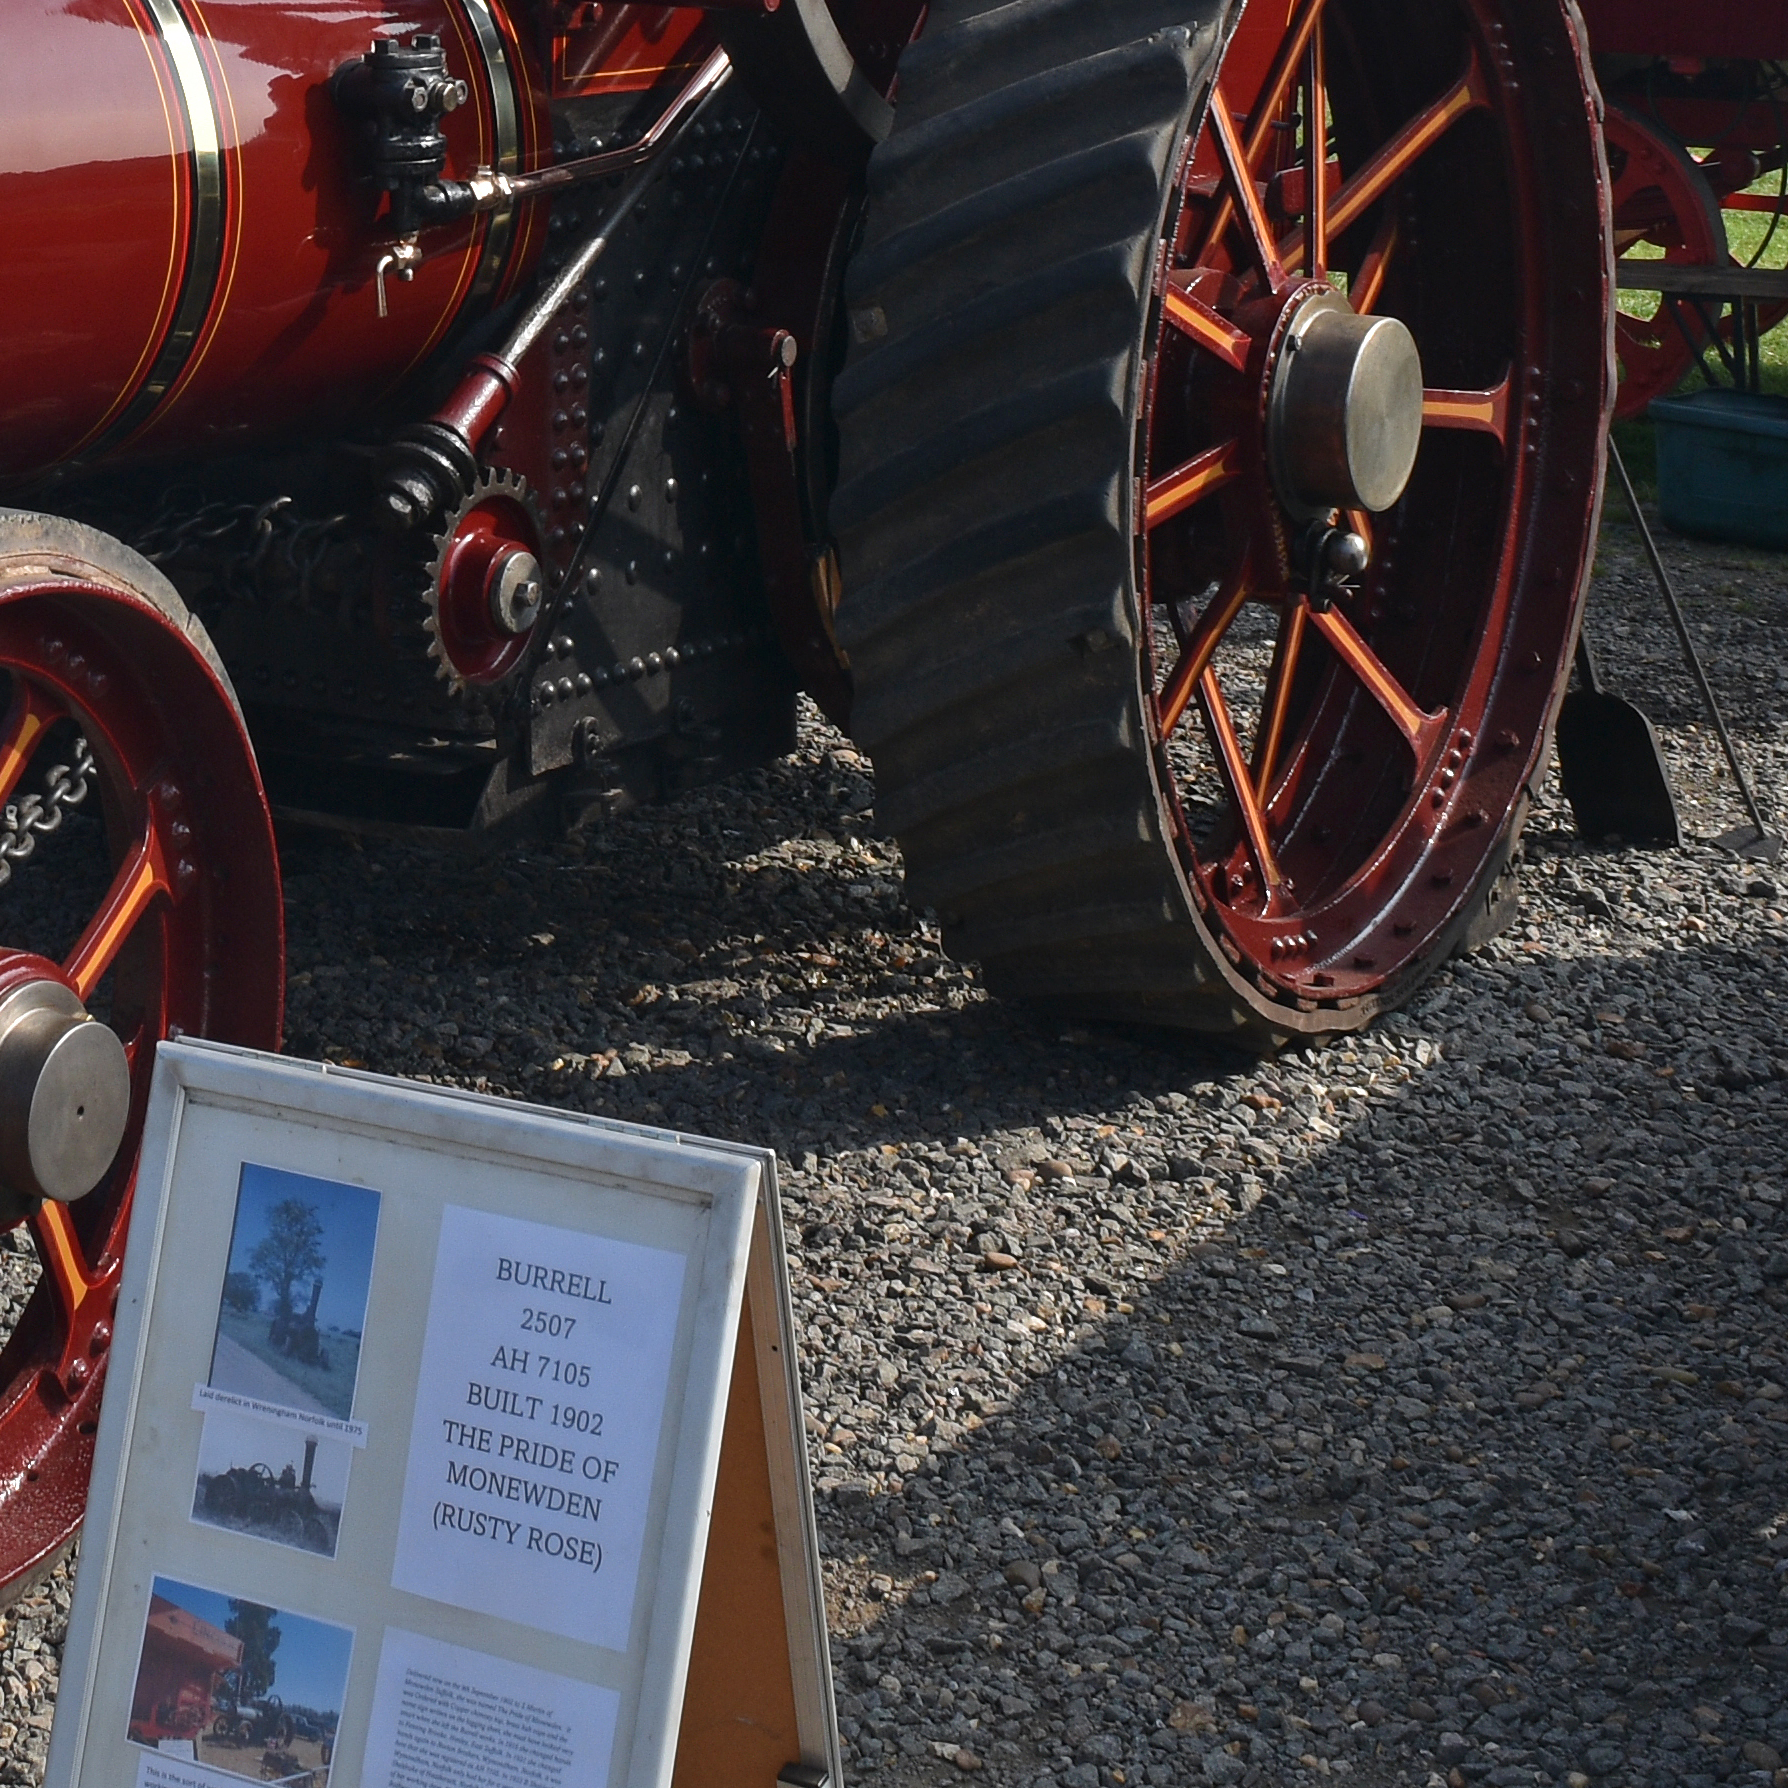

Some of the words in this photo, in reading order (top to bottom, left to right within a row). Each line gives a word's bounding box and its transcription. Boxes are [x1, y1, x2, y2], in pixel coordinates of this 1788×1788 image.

[496, 1257, 612, 1305] BURRELL
[521, 1308, 576, 1339] 2507
[490, 1345, 530, 1374] AH
[538, 1355, 592, 1388] 7105
[199, 1389, 214, 1400] Laid
[215, 1392, 242, 1407] derelict
[243, 1399, 251, 1408] in
[298, 1412, 325, 1426] Norfolk
[326, 1419, 344, 1431] until
[344, 1424, 363, 1436] 1975
[466, 1382, 543, 1420] BUILT
[551, 1403, 604, 1436] 1902
[442, 1419, 492, 1453] THE
[498, 1433, 576, 1474] PRIDE
[582, 1456, 619, 1484] OF
[446, 1460, 602, 1522] MONEWDEN
[432, 1501, 522, 1546] (RUSTY
[526, 1526, 603, 1574] ROSE)
